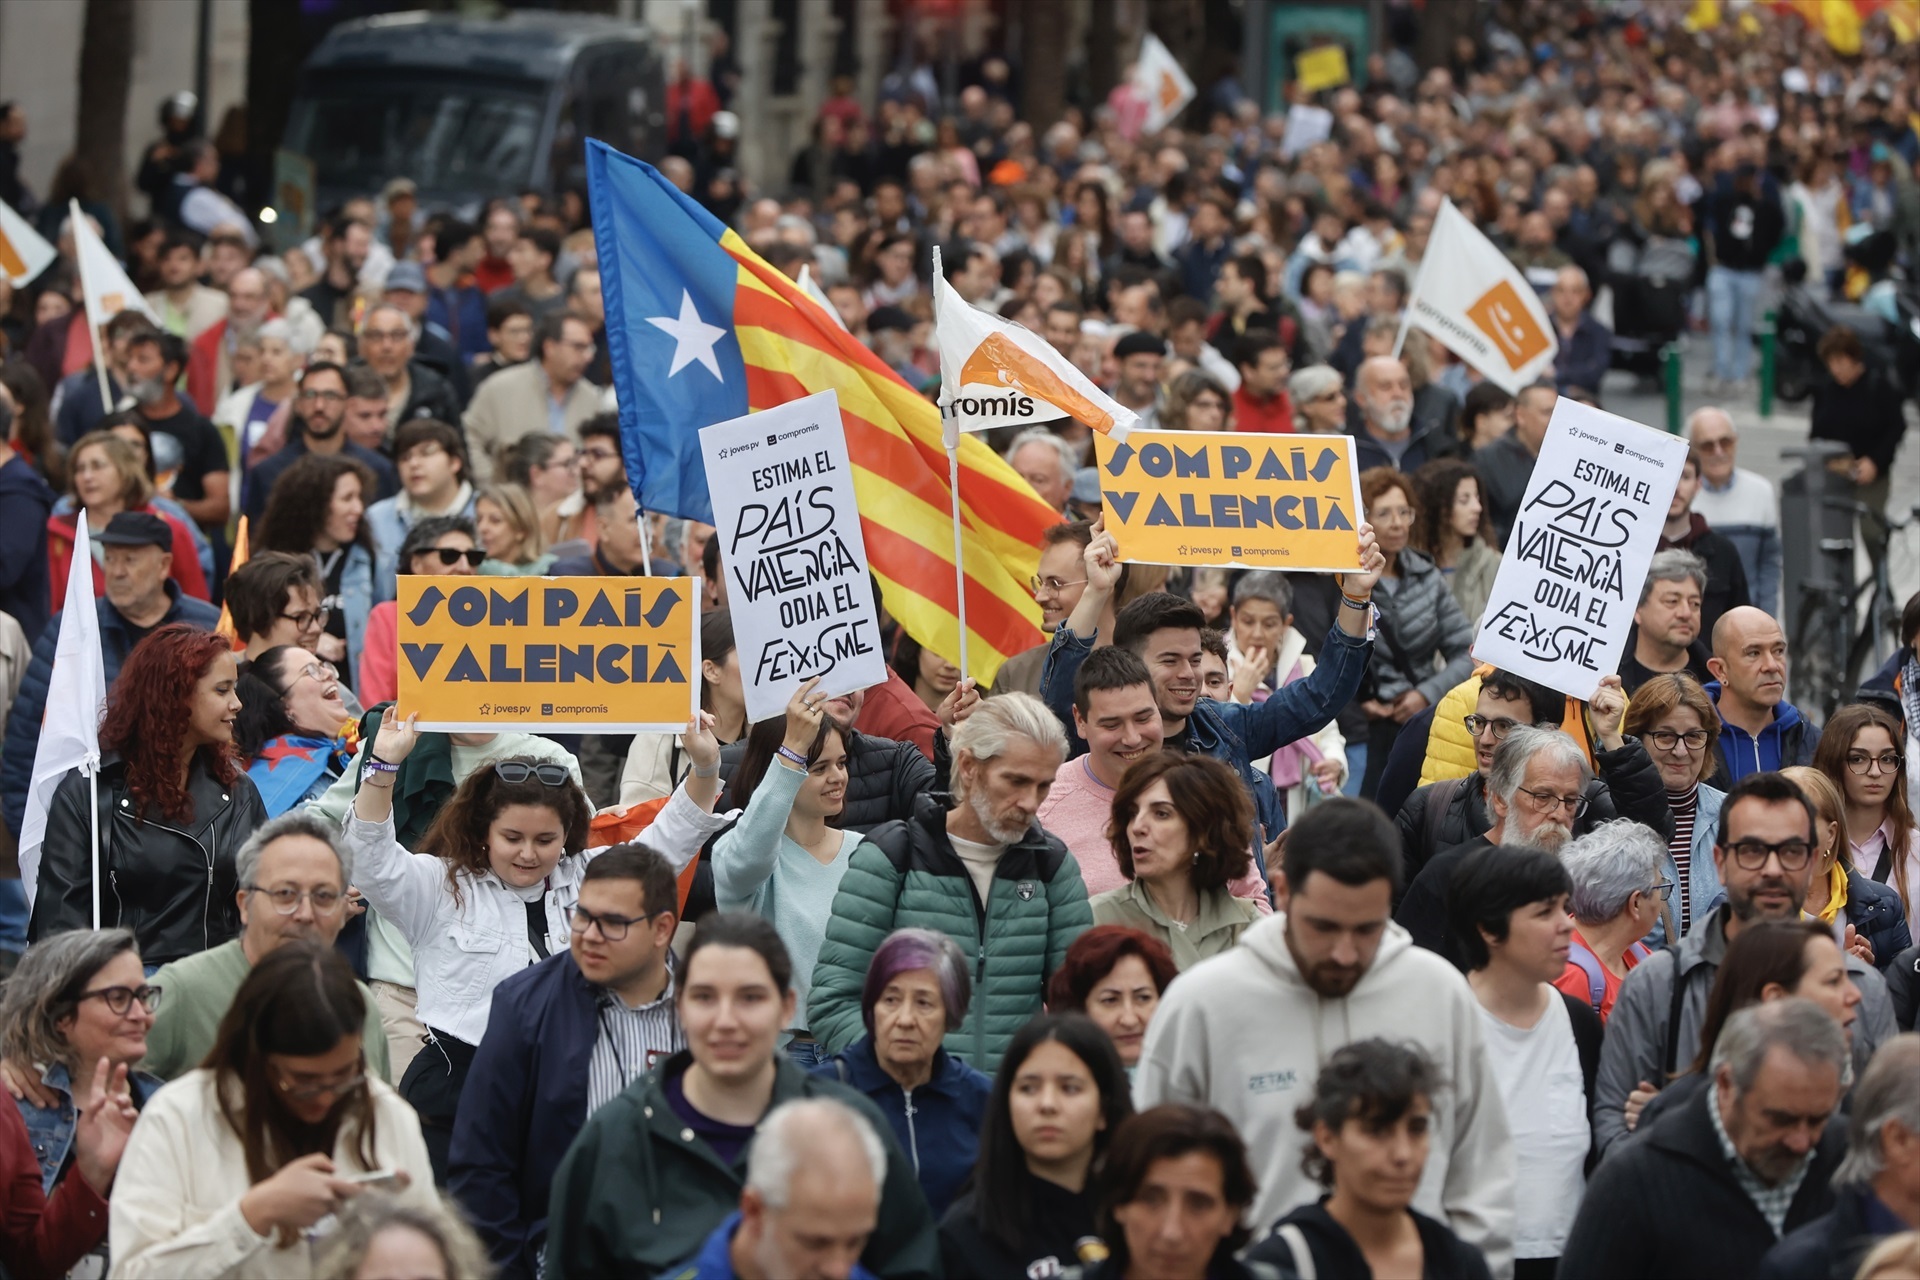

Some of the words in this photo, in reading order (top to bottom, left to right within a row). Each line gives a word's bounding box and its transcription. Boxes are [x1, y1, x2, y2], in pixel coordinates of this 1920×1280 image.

[941, 391, 1035, 419] romís
[778, 423, 820, 441] compromís
[1578, 429, 1599, 443] joves
[1598, 437, 1608, 447] pv
[729, 444, 750, 457] joves
[750, 440, 760, 451] pv
[1625, 448, 1665, 469] compromís
[752, 456, 813, 493] ESTIMA
[815, 449, 836, 474] EL
[1104, 443, 1211, 479] SOM
[1220, 445, 1341, 483] PAÍS
[1573, 458, 1631, 497] ESTIMA
[1632, 480, 1651, 505] EL
[1102, 490, 1354, 531] VALENCIÀ
[1190, 545, 1211, 556] joves
[1212, 547, 1223, 556] pv
[1244, 546, 1290, 557] compromís
[405, 585, 529, 627] SOM
[543, 587, 683, 628] PAÍS
[780, 591, 830, 629] ODIA
[833, 583, 860, 614] EL
[1534, 578, 1581, 618] ODIA
[1585, 597, 1608, 629] EL
[400, 643, 687, 684] VALENCIÀ
[493, 703, 518, 715] joves
[519, 704, 531, 716] pv
[555, 703, 609, 716] compromís
